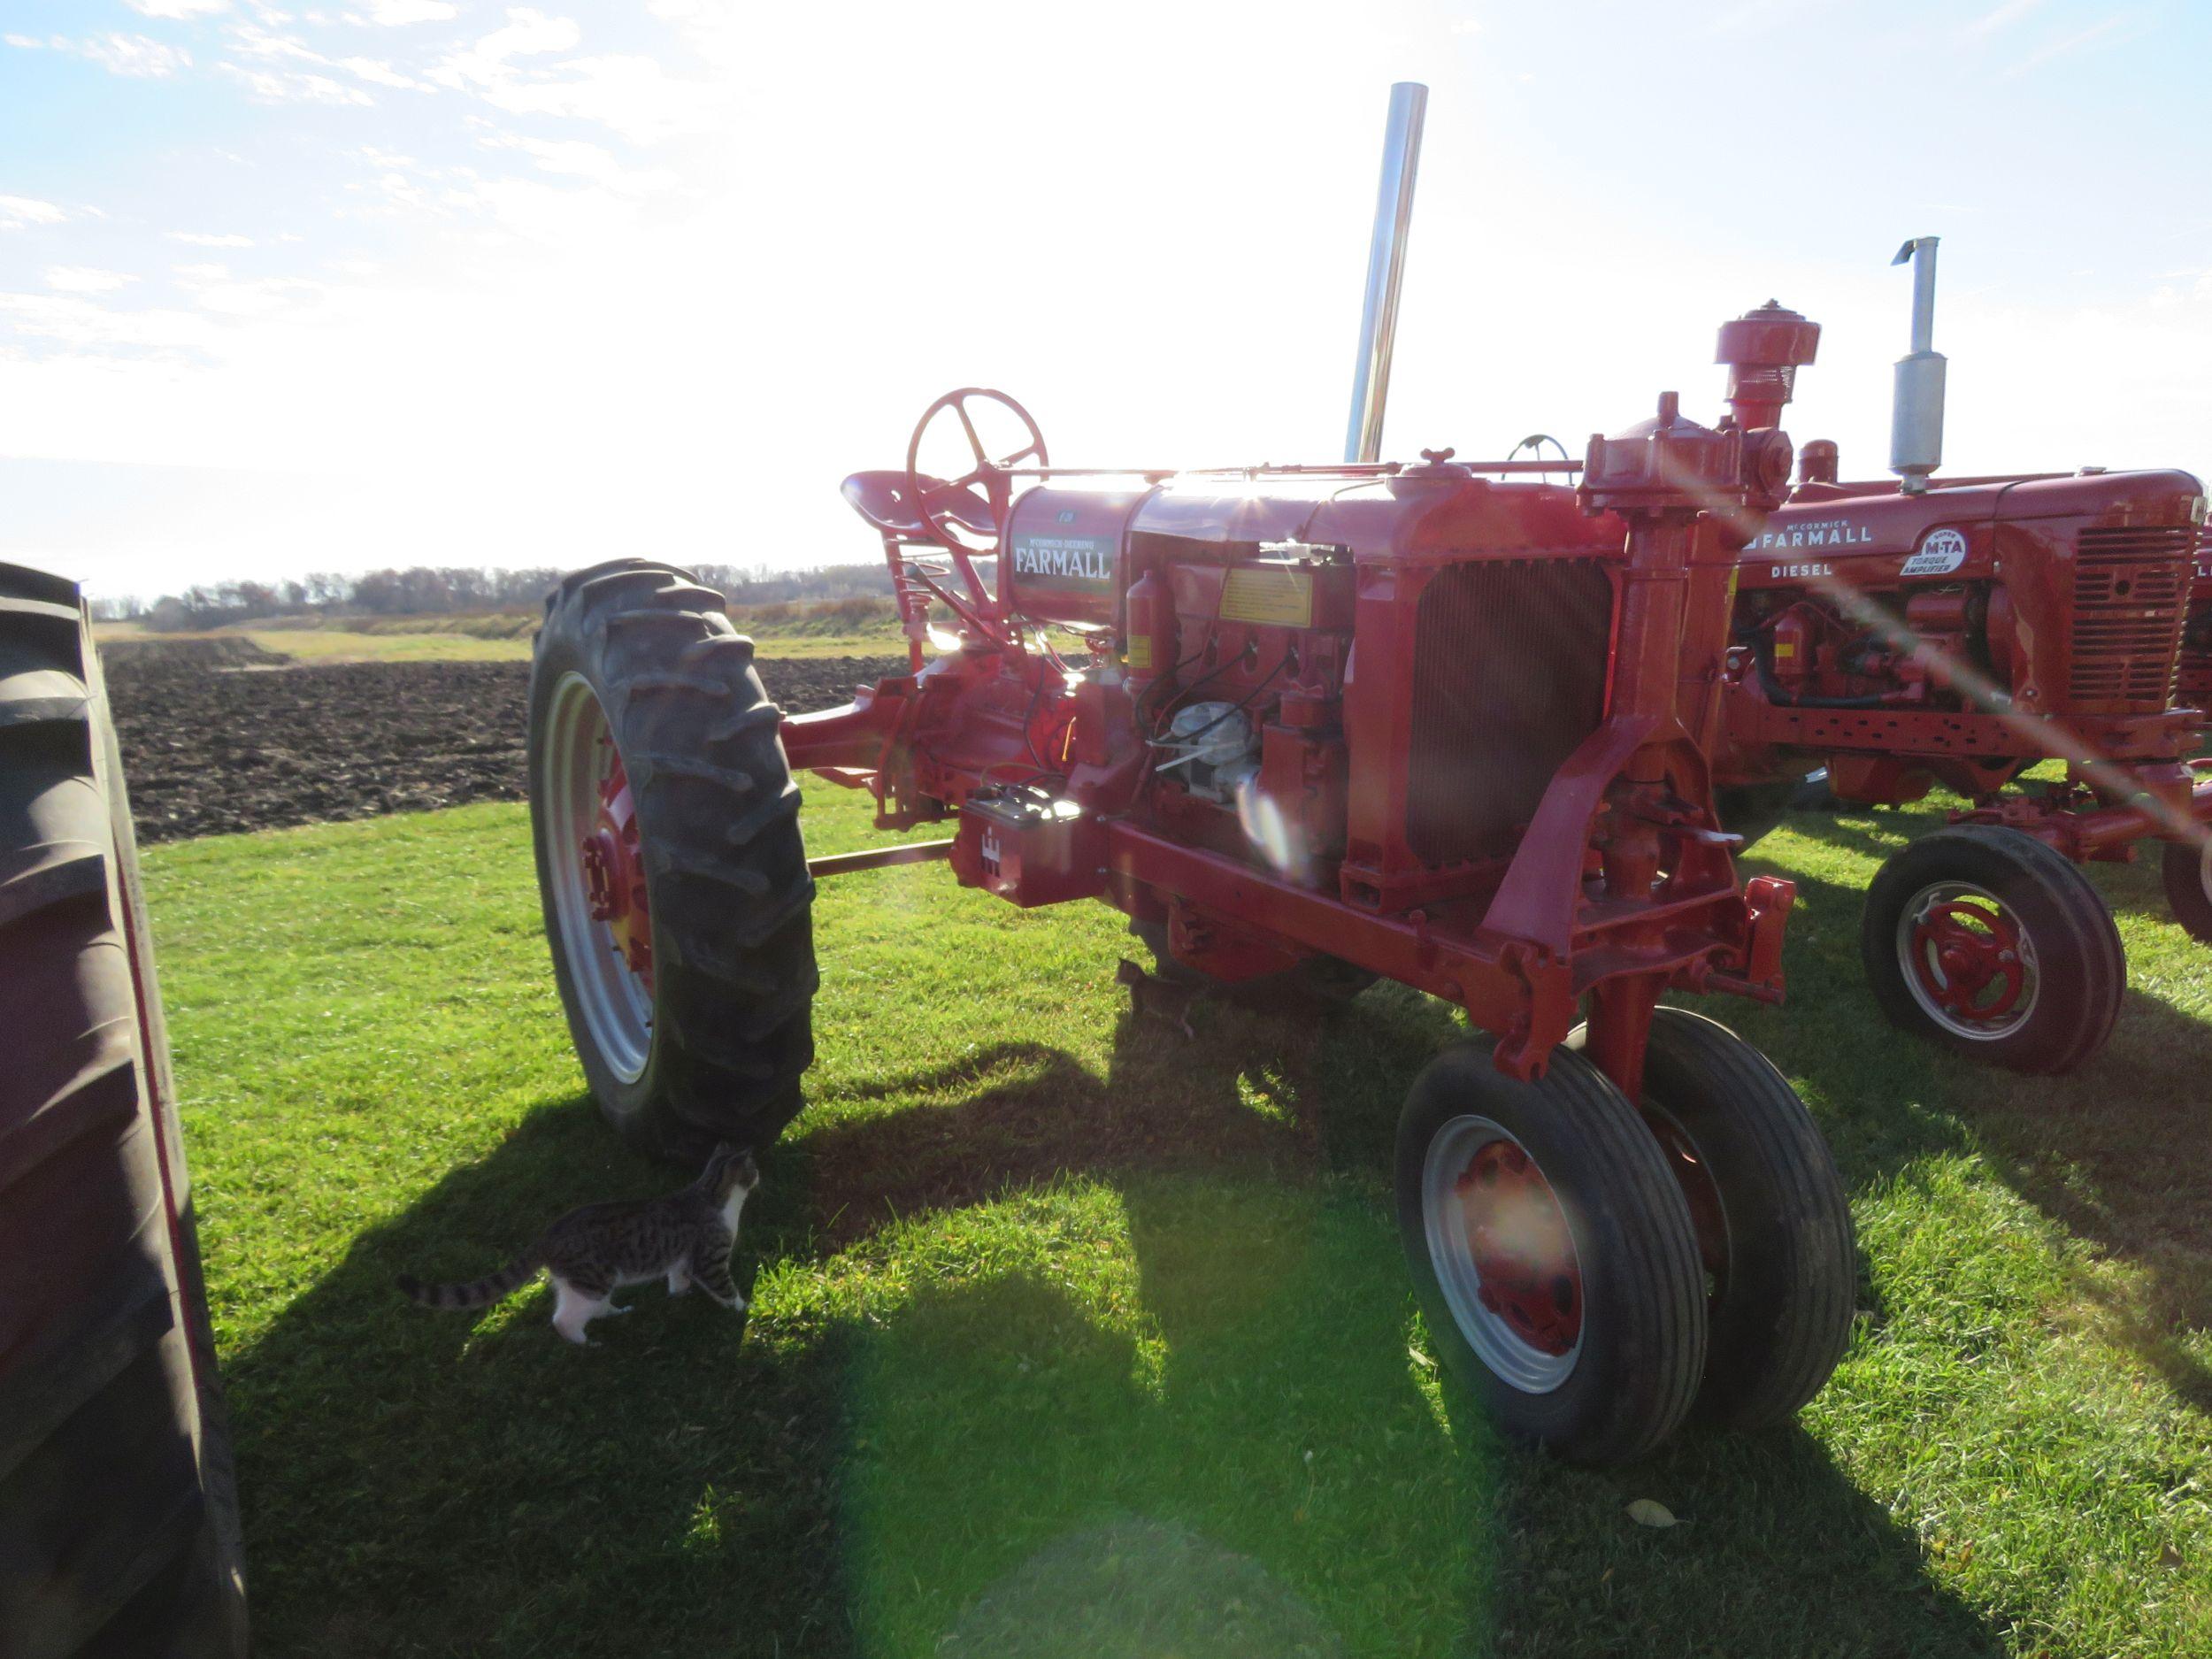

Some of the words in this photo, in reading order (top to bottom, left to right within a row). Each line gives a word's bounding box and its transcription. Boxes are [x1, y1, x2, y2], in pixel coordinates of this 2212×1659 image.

[1762, 526, 1872, 549] FARMALL
[1015, 547, 1110, 580] FARMALL
[1911, 556, 1947, 565] TORQUE
[1771, 563, 1832, 578] DIESEL
